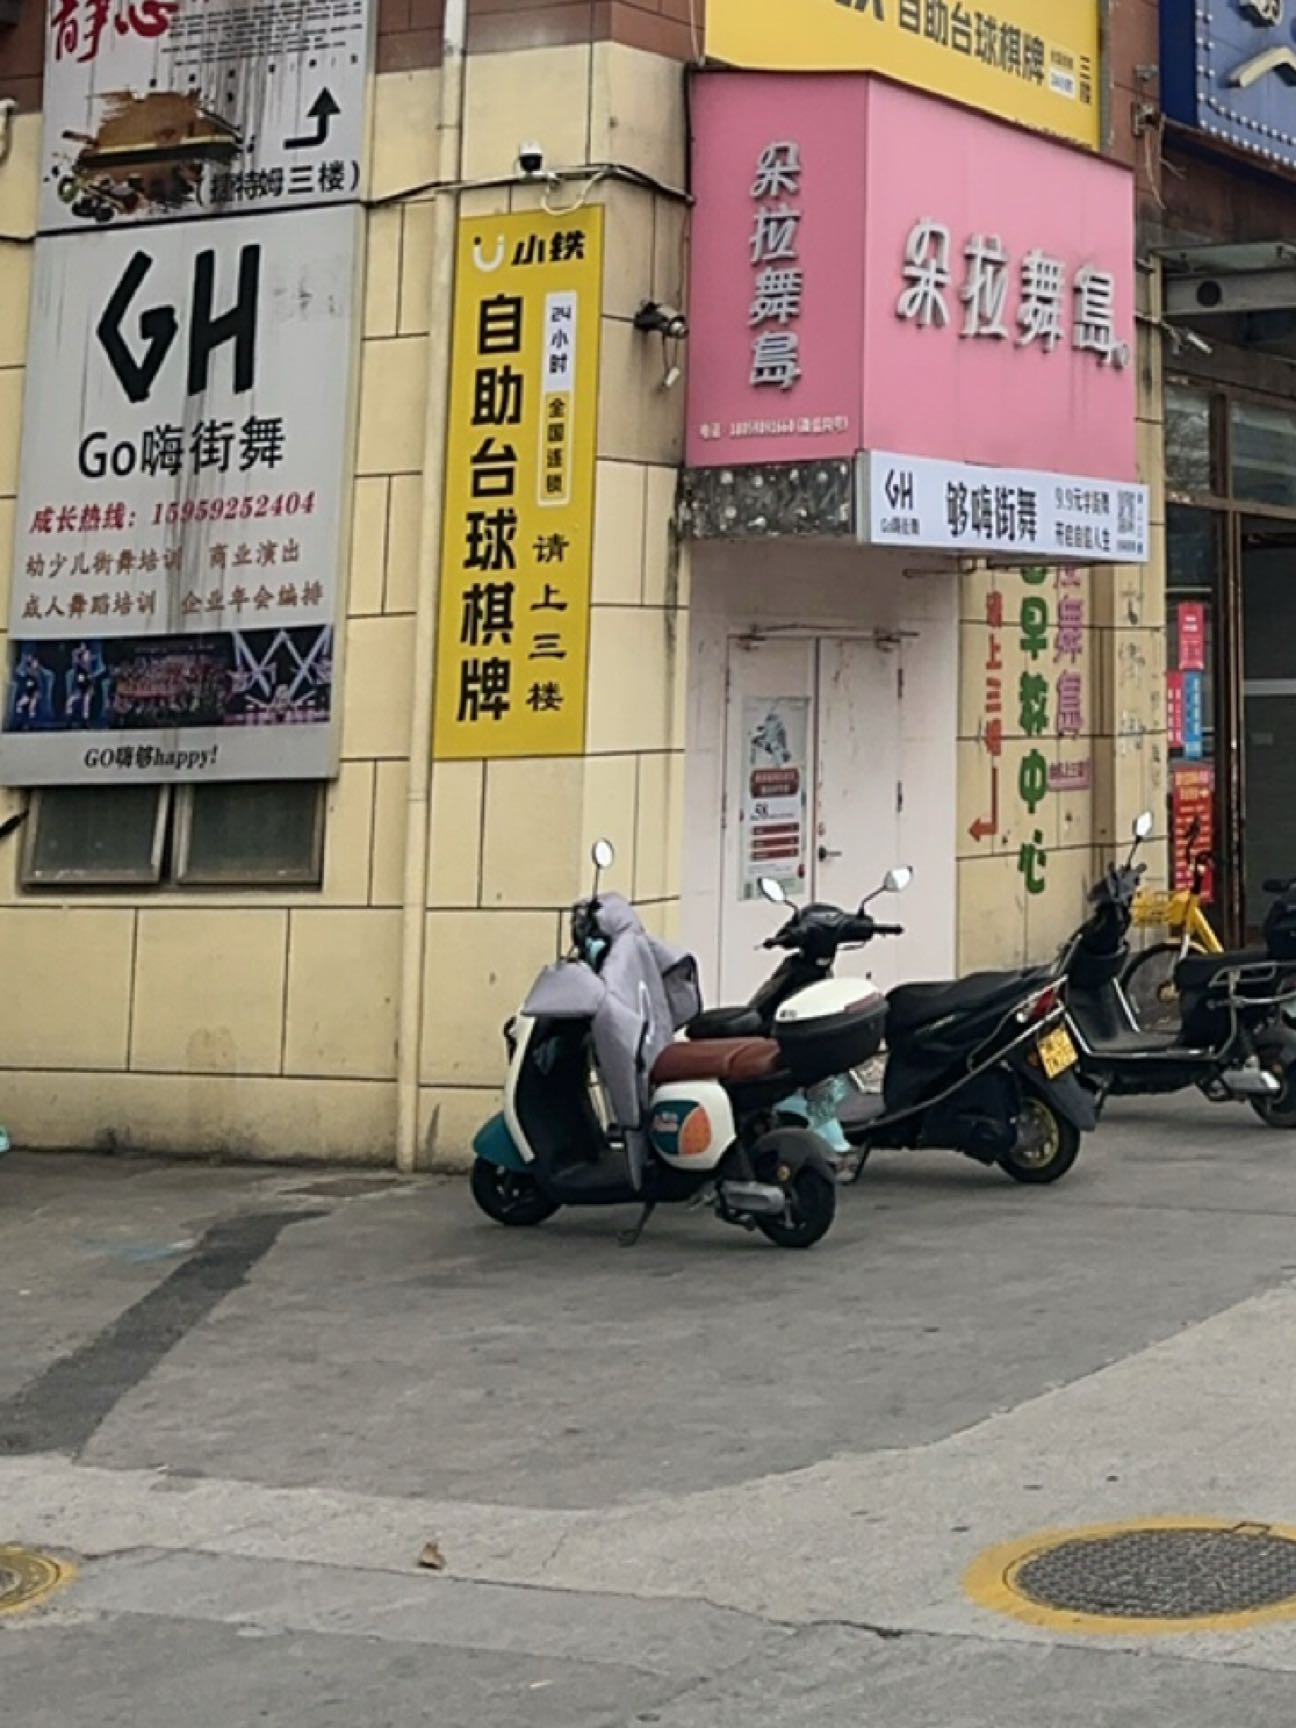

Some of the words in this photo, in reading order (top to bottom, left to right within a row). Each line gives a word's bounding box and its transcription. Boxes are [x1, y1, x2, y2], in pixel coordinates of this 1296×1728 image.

[511, 230, 586, 267] 小铁
[97, 243, 261, 403] GH
[78, 417, 286, 478] Go嗨街舞
[150, 491, 316, 526] 15959252404
[456, 293, 524, 722] 自助台球棋牌
[885, 469, 914, 510] GH
[947, 480, 1038, 542] 够嗨街舞
[26, 544, 183, 578] 幼少儿街舞培训
[208, 538, 301, 570] 商业演出
[525, 532, 570, 712] 请上三楼
